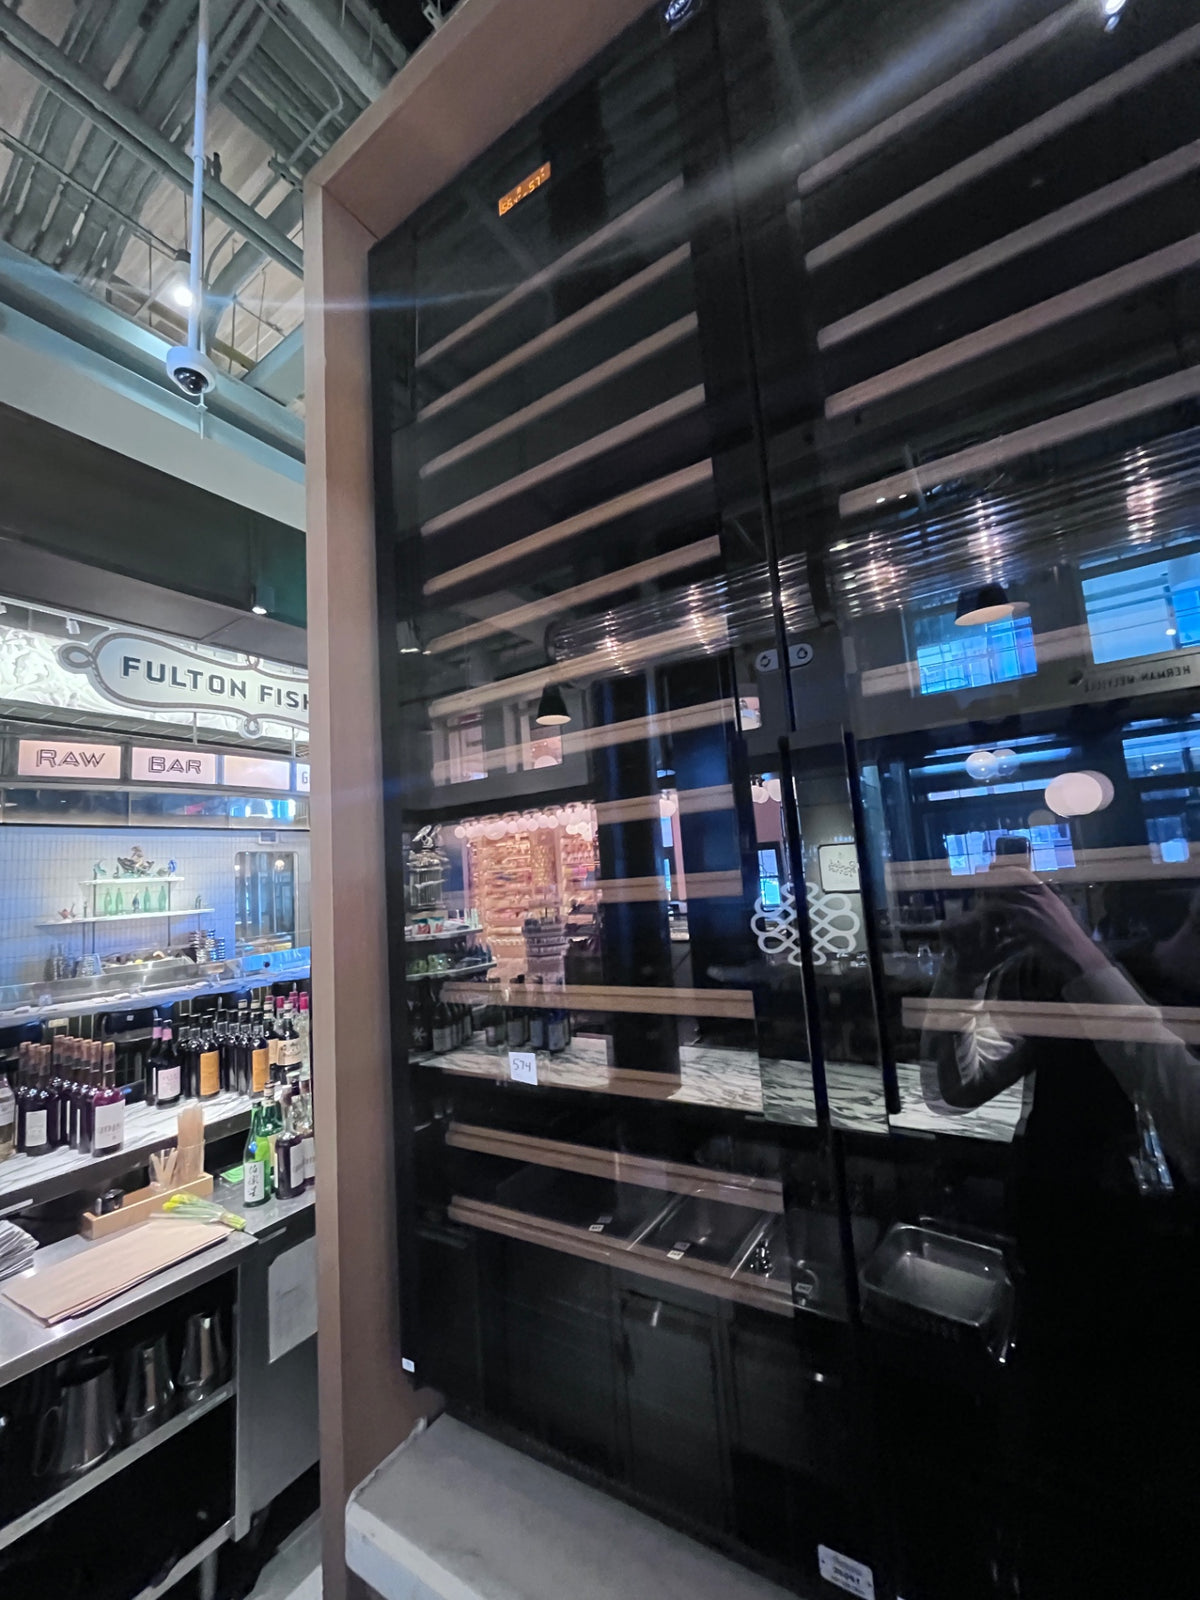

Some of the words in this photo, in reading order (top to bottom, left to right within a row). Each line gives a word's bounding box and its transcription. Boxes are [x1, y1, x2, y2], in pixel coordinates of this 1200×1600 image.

[122, 655, 247, 699] FULTON
[36, 749, 105, 768] RAW
[148, 756, 202, 774] BAR
[512, 1057, 532, 1072] 574
